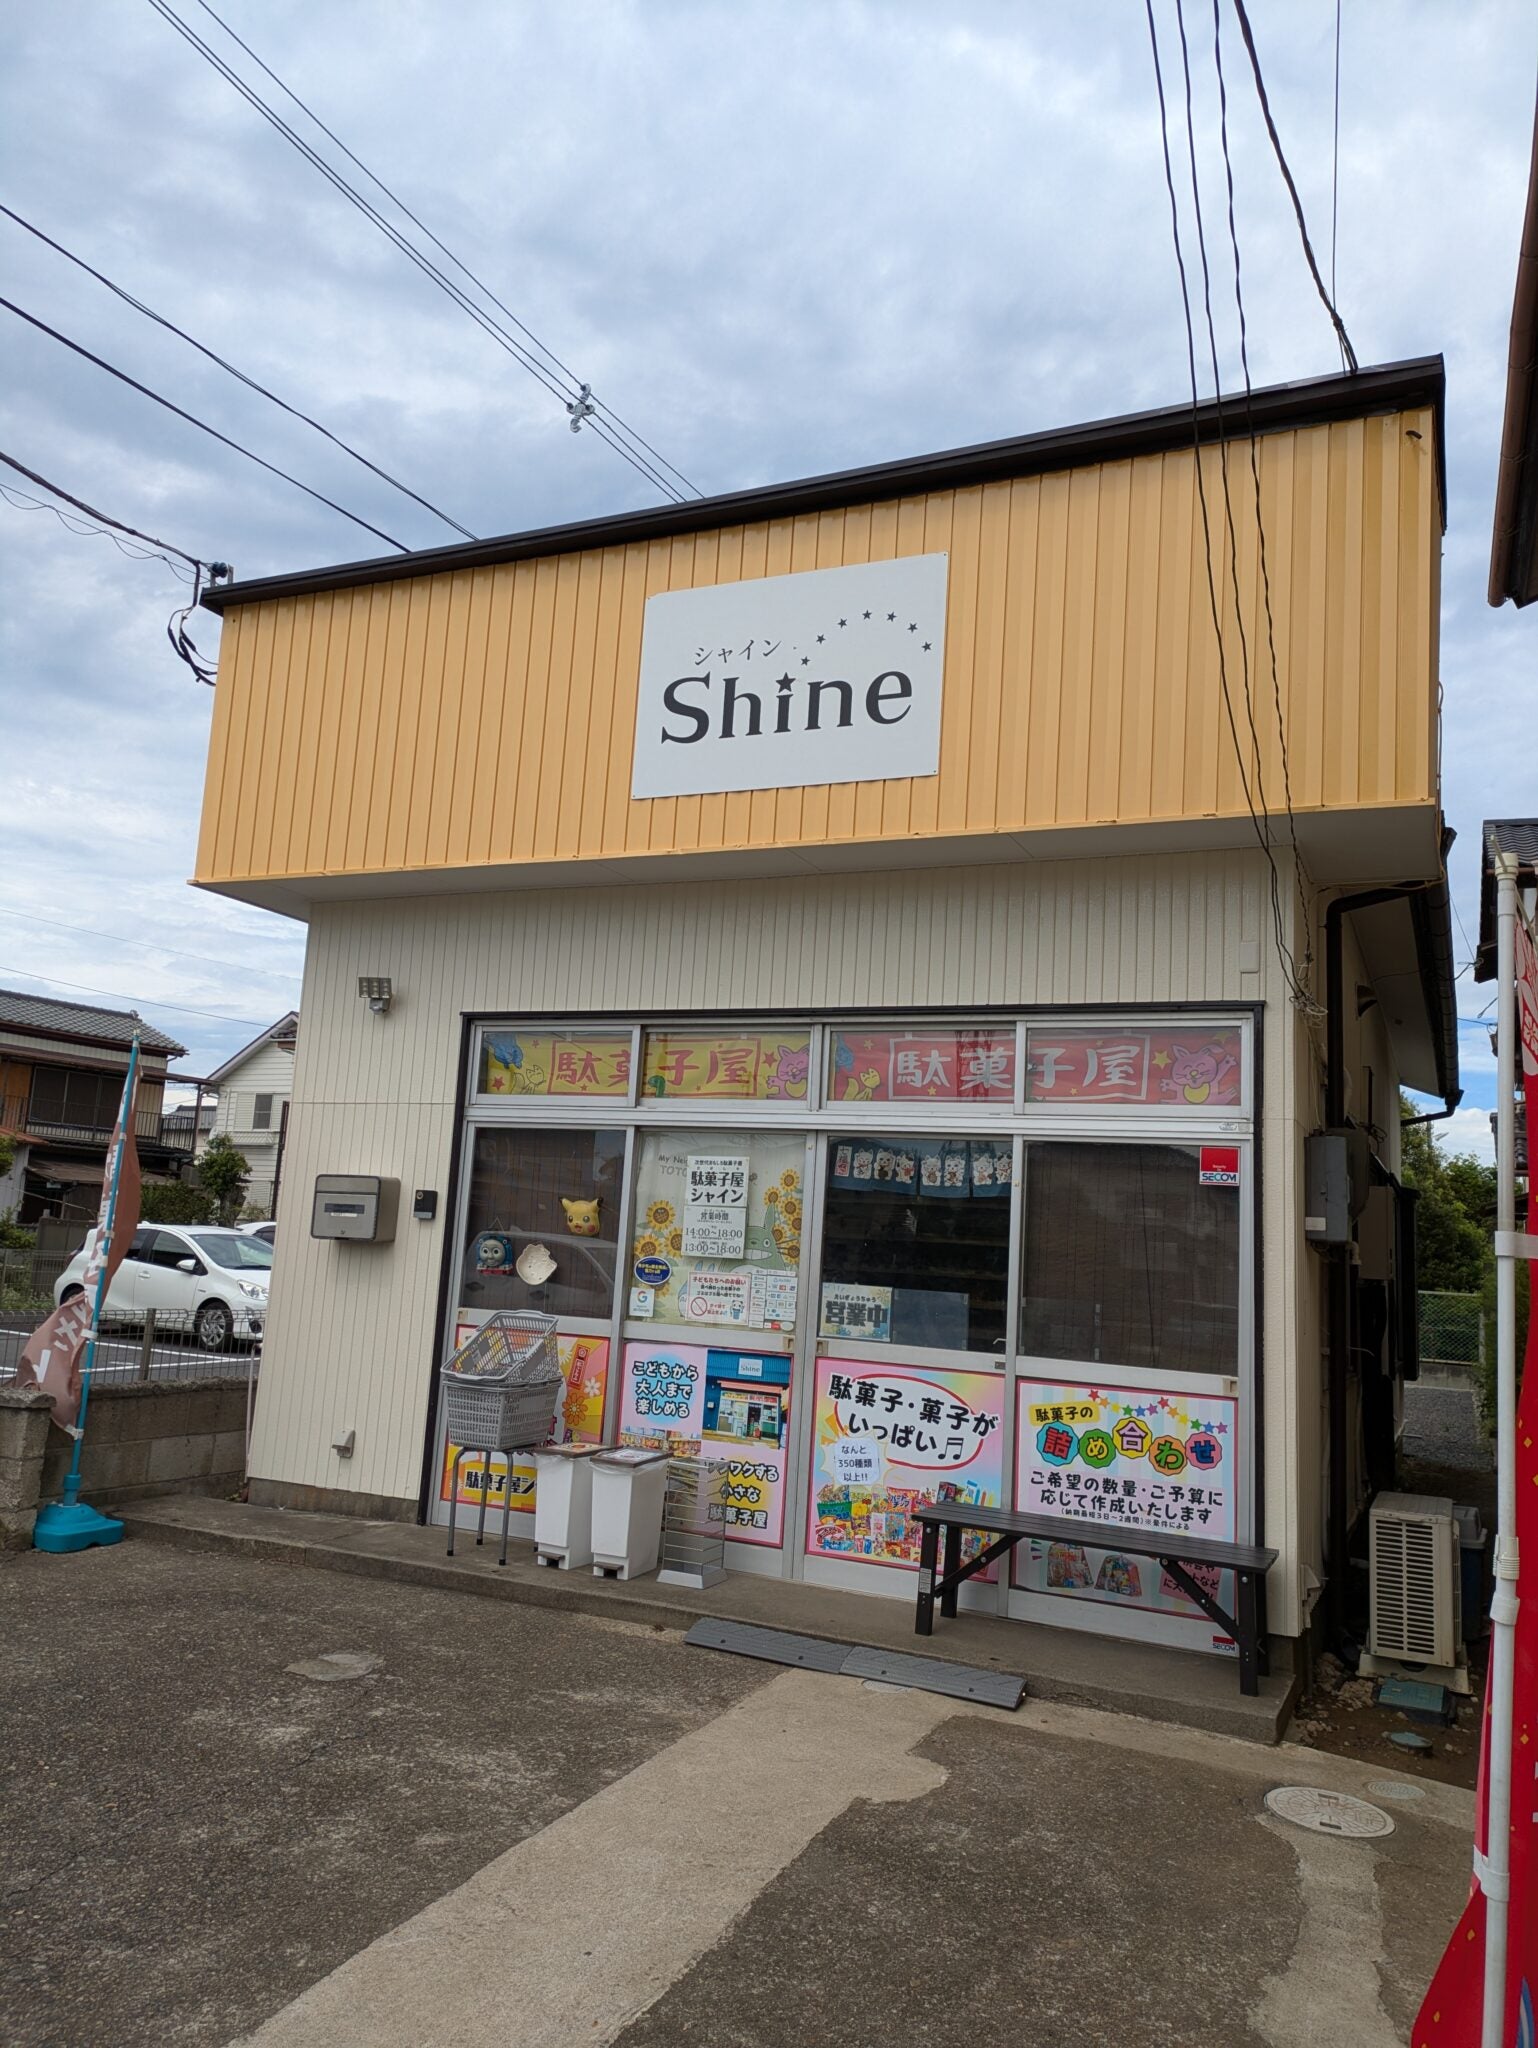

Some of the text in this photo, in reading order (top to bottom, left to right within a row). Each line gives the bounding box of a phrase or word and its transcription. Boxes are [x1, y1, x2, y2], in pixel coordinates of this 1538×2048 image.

[694, 639, 782, 666] シャイン
[661, 670, 913, 744] Shine
[896, 1046, 1141, 1090] 駄菓子屋
[690, 1170, 745, 1188] 駄菓子屋
[1202, 1172, 1237, 1182] SECOM
[691, 1188, 744, 1204] シャイン
[825, 1300, 889, 1328] 営業中
[632, 1360, 699, 1382] こどもから
[635, 1379, 693, 1400] 大人まで
[635, 1396, 690, 1418] 楽しめる
[829, 1374, 999, 1437] 駄菓子・菓子が
[1035, 1406, 1093, 1422] 駄菓子の
[849, 1413, 938, 1452] いっぱい
[1043, 1420, 1216, 1470] 詰め合わせ
[841, 1445, 868, 1455] なんと
[838, 1459, 873, 1469] 350種類
[1030, 1470, 1223, 1506] ご希望の数量・ご予算に
[708, 1503, 768, 1529] 駄菓子屋
[1040, 1489, 1212, 1525] 応じて作成いたします
